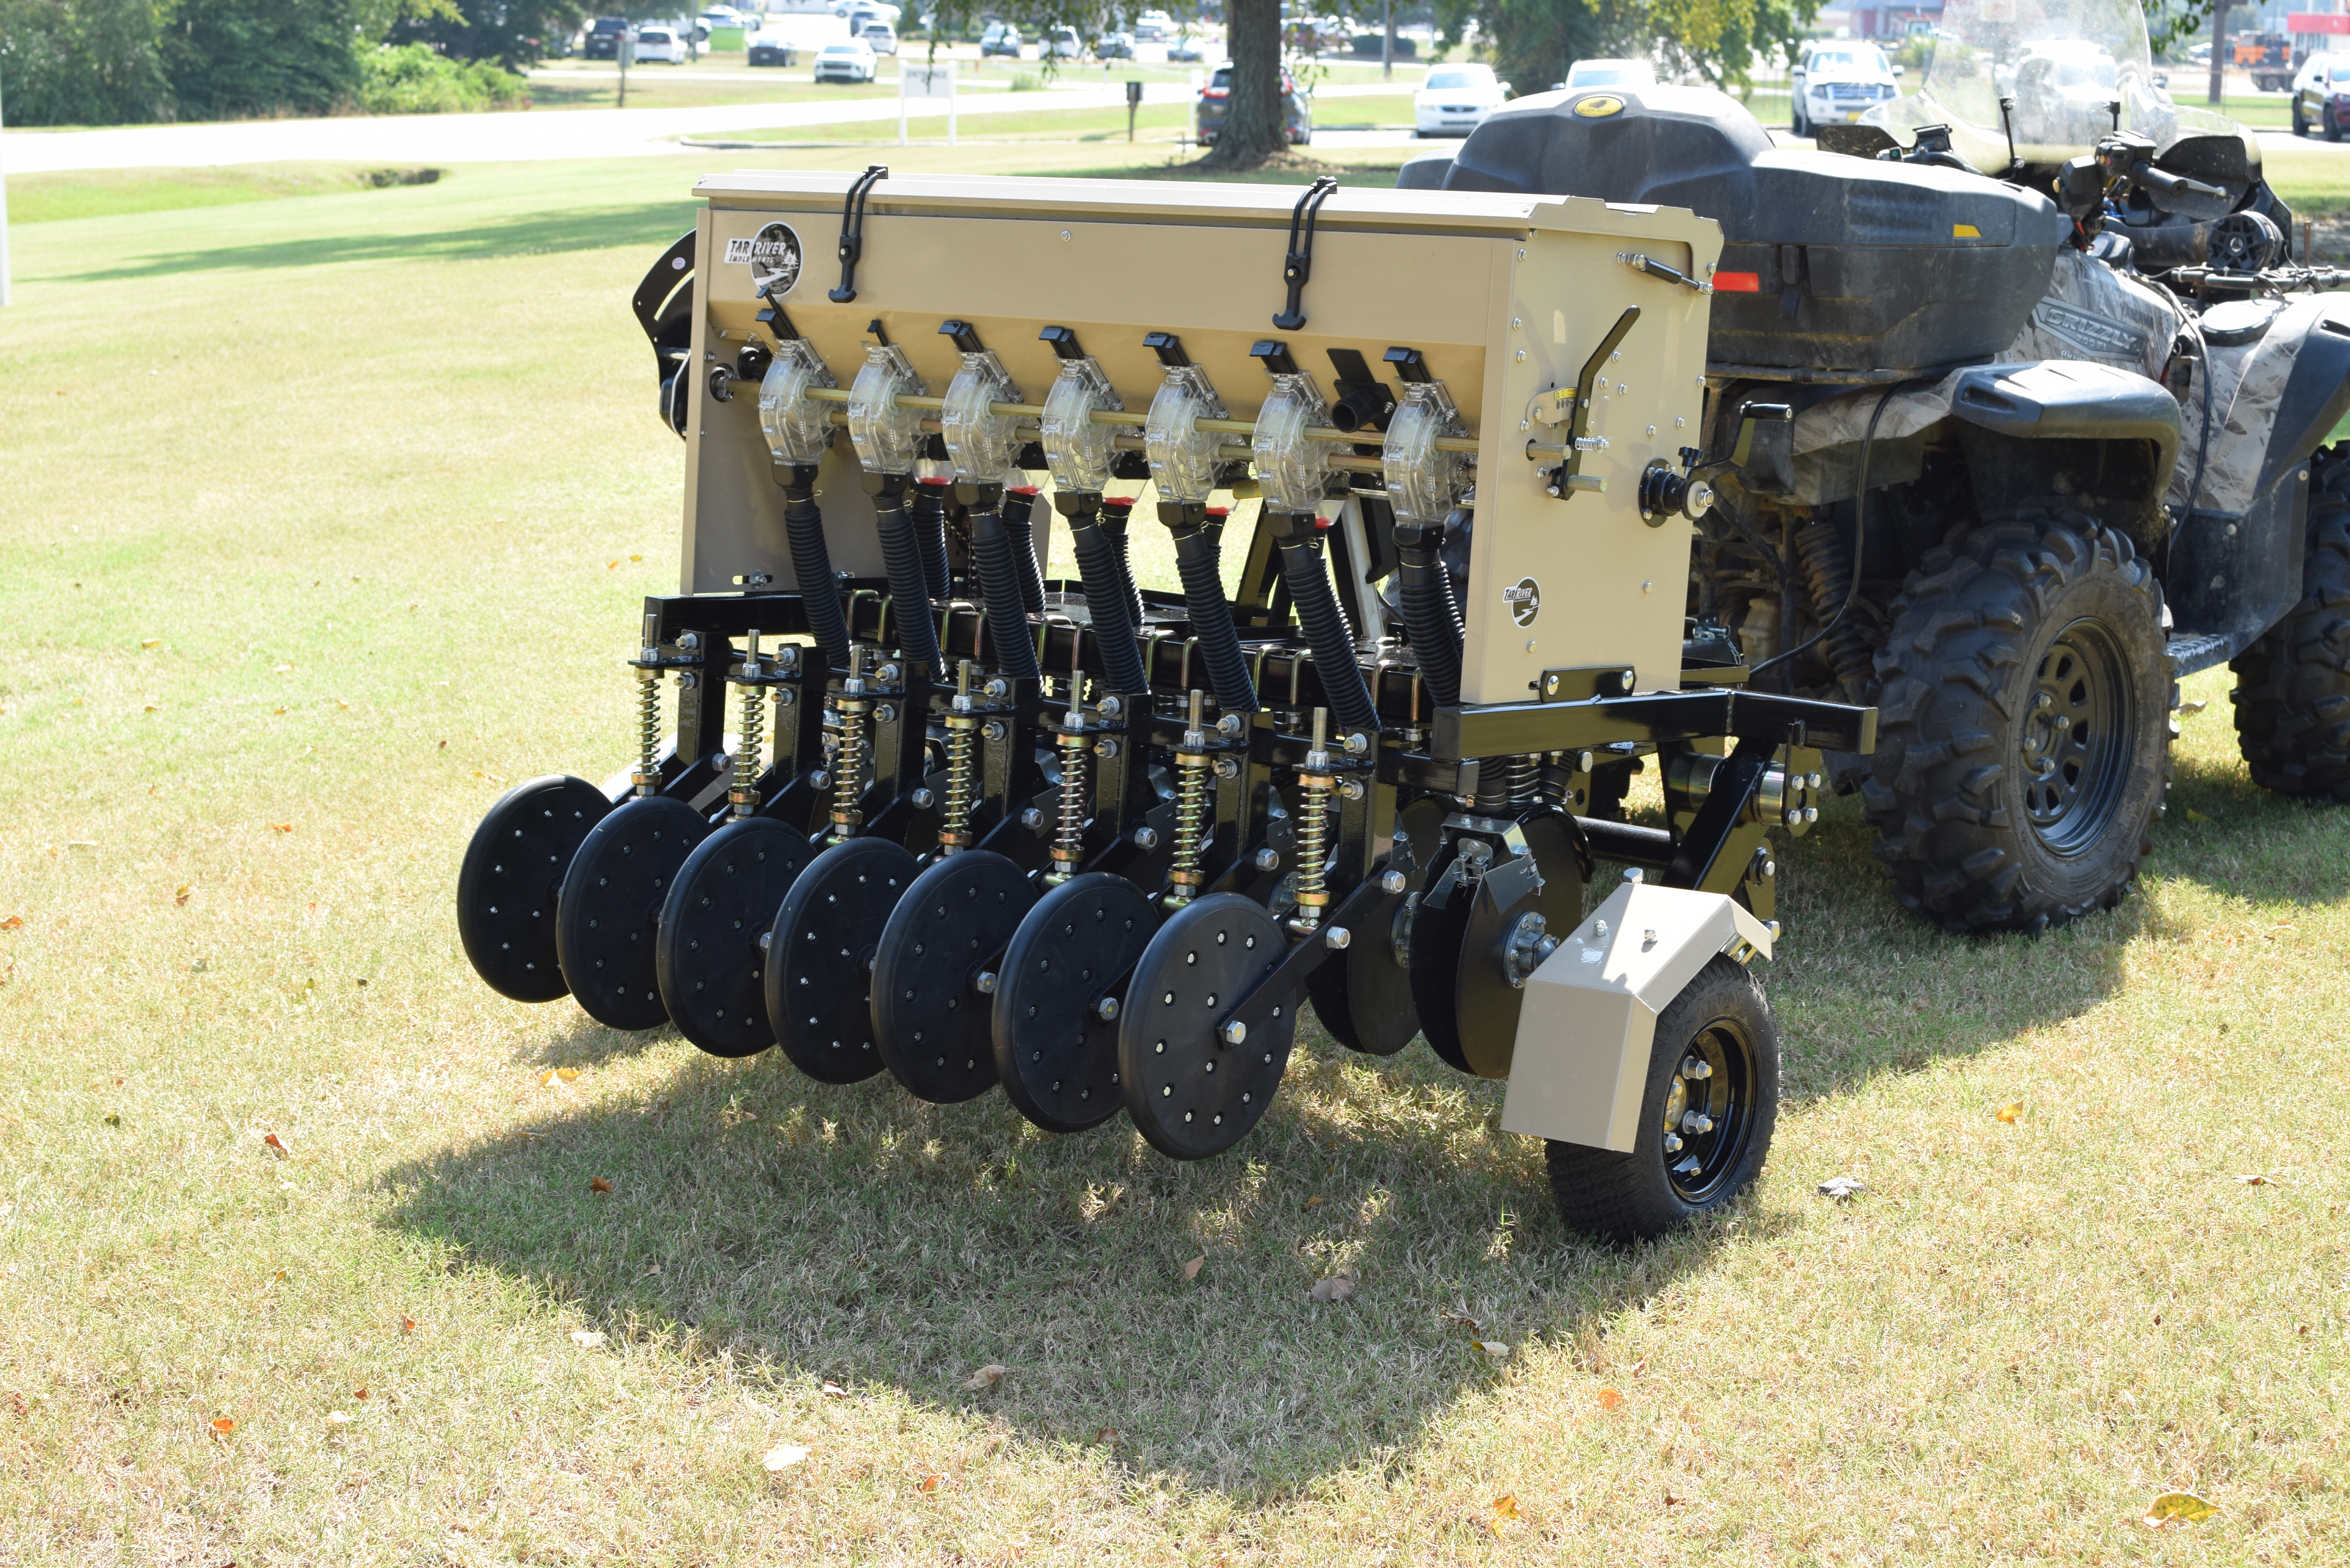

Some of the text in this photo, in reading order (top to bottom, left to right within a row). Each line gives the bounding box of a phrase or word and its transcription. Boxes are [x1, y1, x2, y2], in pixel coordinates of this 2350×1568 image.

[731, 240, 786, 256] TAR RIVER
[729, 254, 774, 263] IMPLEMENTS
[2046, 307, 2138, 350] GRIZZLY
[2076, 334, 2095, 346] 700
[1504, 587, 1533, 599] TAR RIVER
